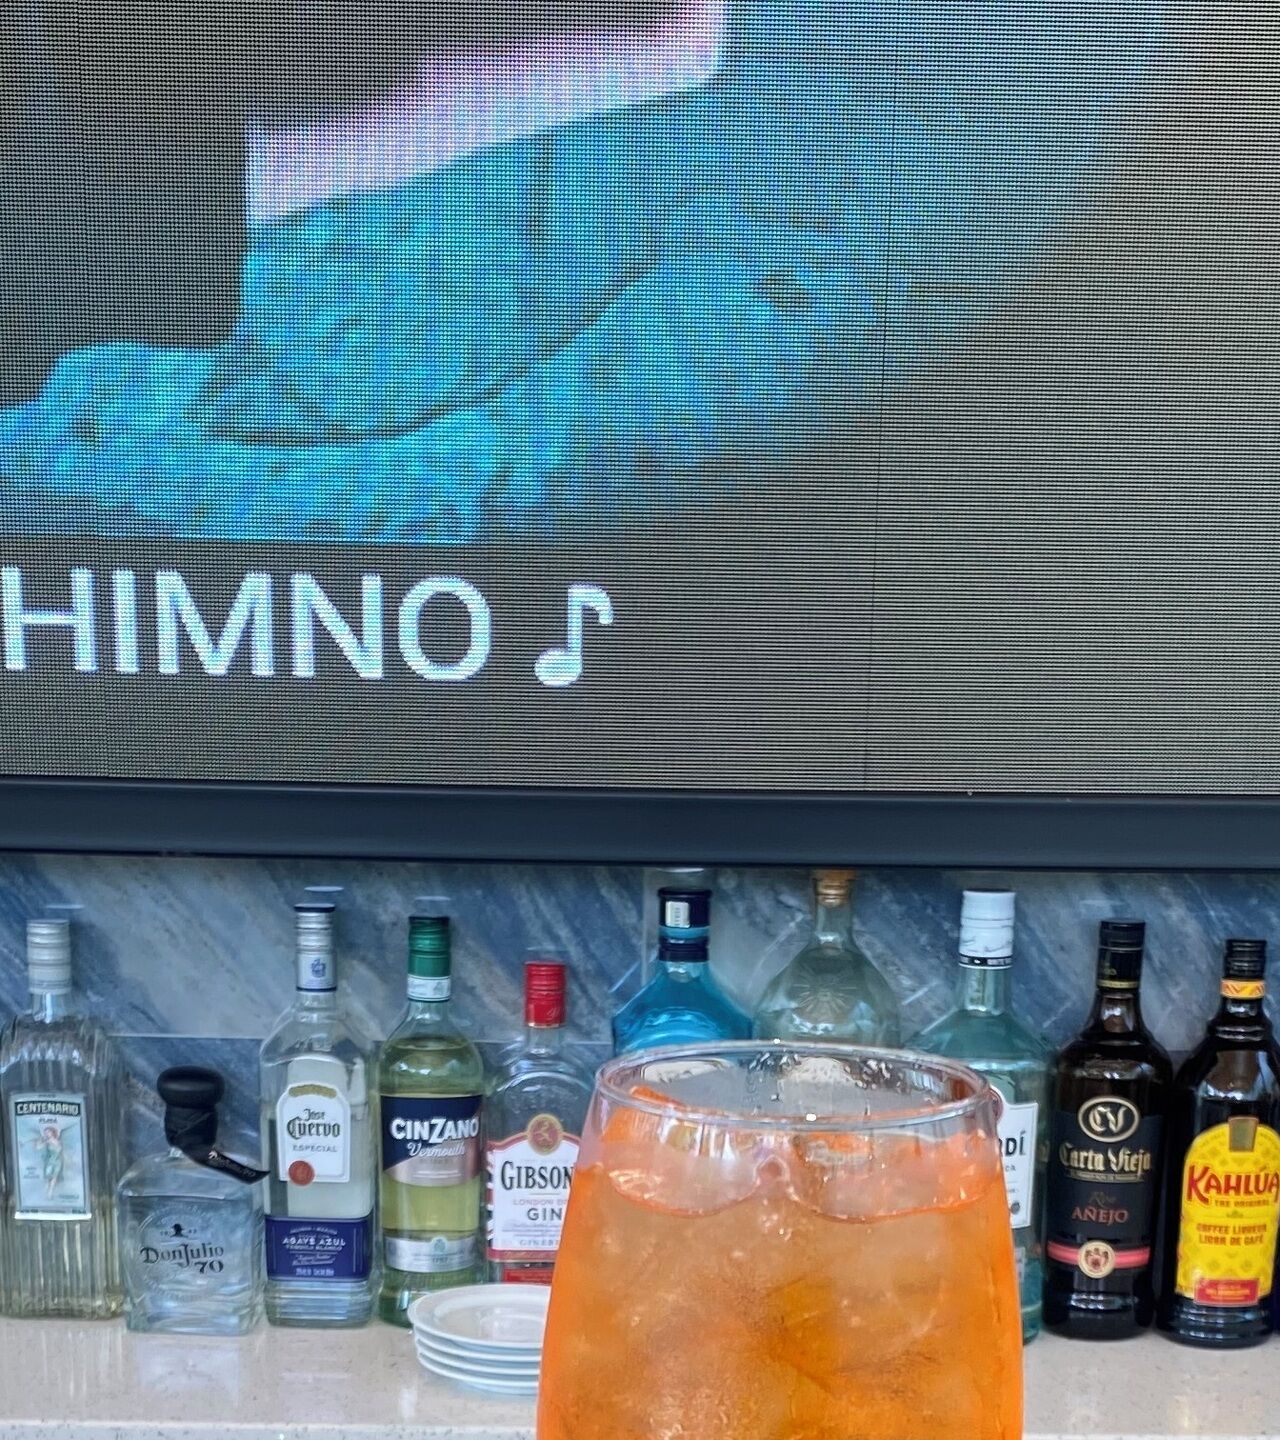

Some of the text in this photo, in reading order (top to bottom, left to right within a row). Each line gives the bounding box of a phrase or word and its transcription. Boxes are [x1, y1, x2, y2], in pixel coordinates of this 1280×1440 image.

[0, 564, 493, 682] HIMNO
[16, 1101, 79, 1116] CENTENARIO
[286, 1115, 341, 1141] Cuervo
[390, 1116, 480, 1144] CINZANO
[406, 1141, 466, 1157] Vermouth
[1186, 1164, 1280, 1205] KAHLÚA
[526, 1207, 563, 1221] GIN
[1071, 1205, 1129, 1226] AÑEJO
[193, 1259, 225, 1274] 70
